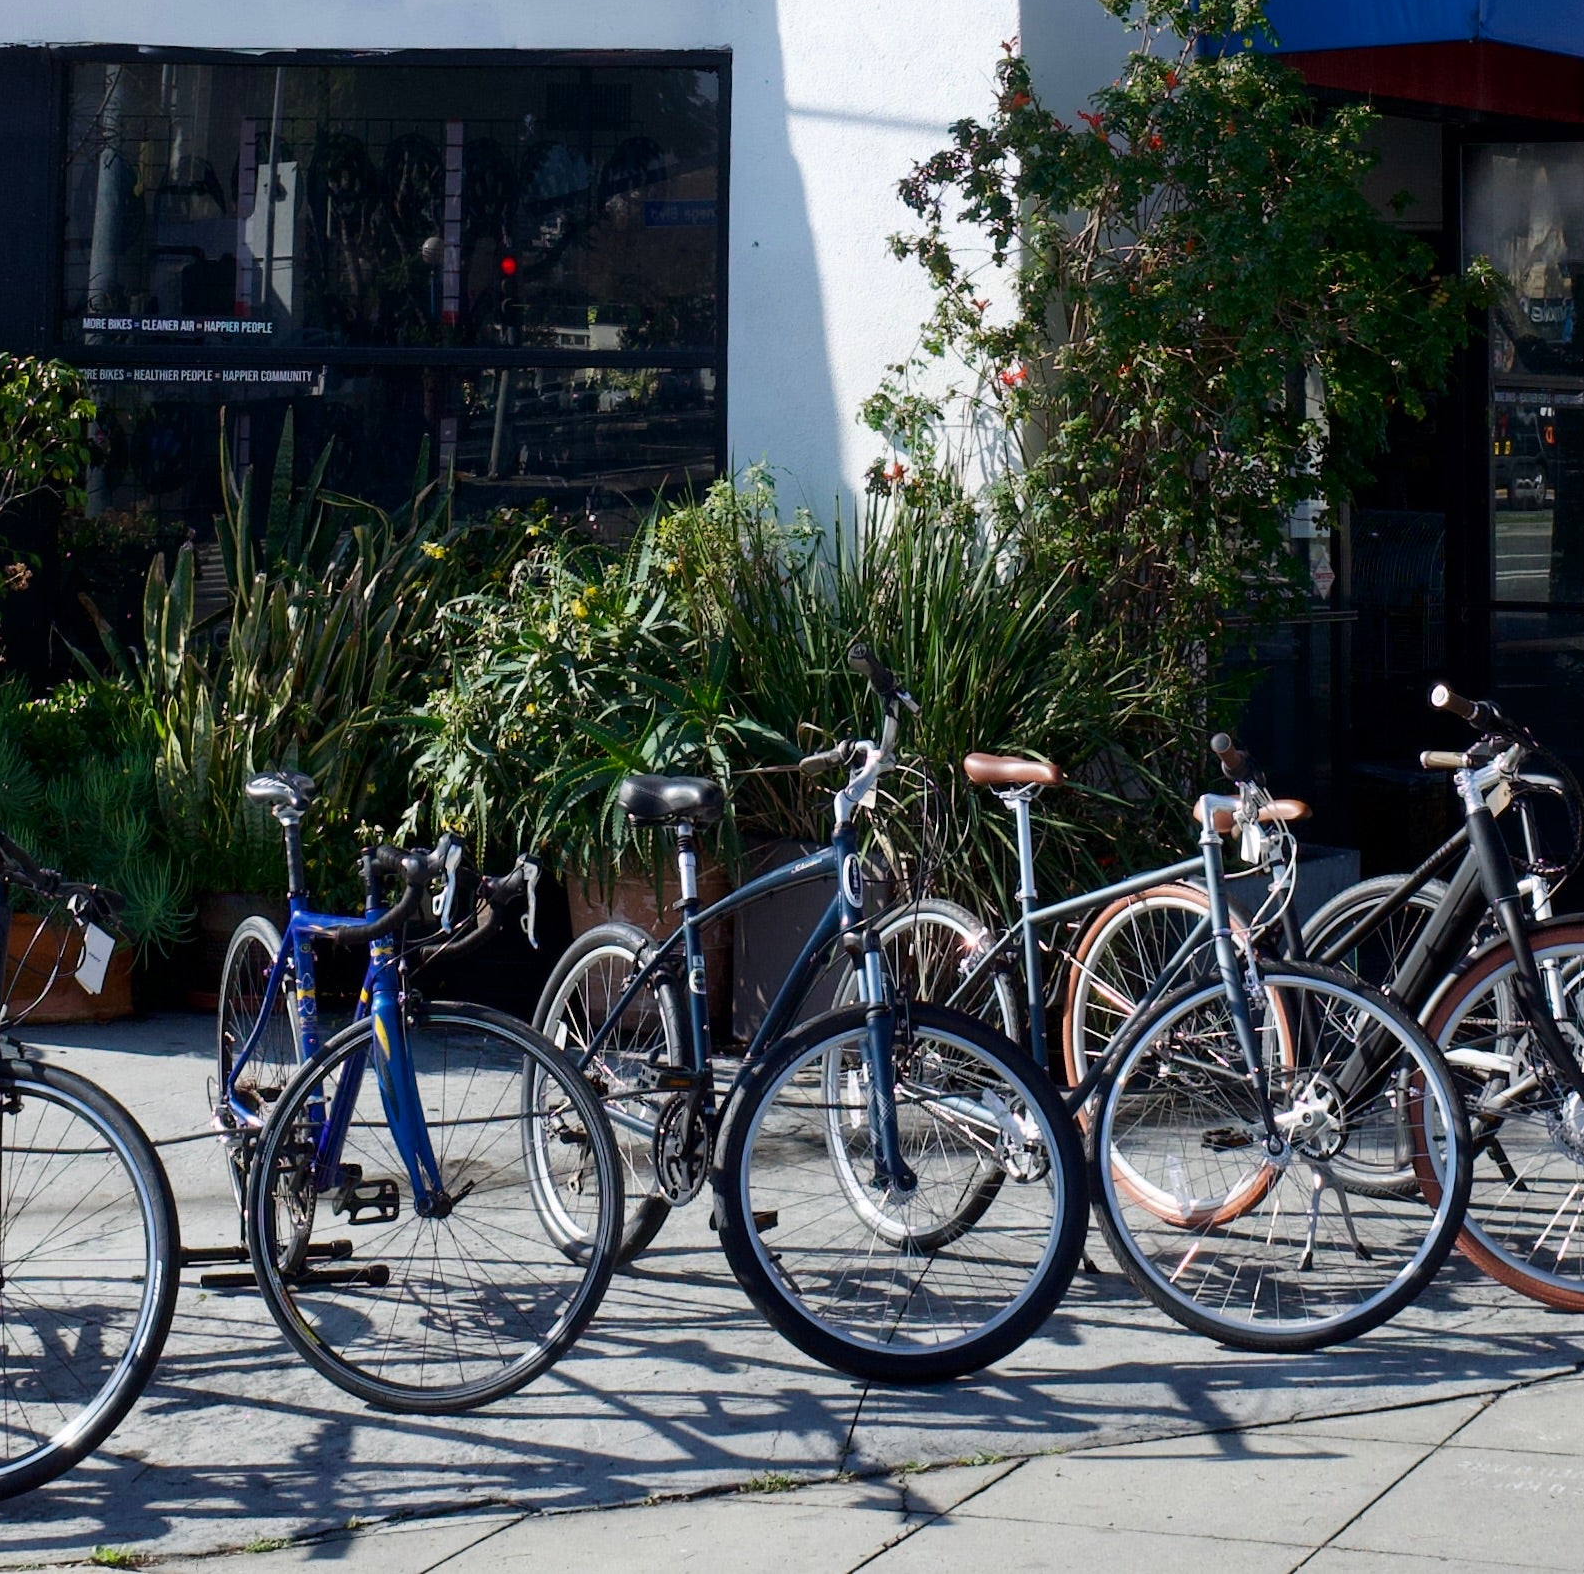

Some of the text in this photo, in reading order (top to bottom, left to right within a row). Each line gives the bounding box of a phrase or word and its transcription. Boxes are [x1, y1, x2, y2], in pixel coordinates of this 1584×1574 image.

[83, 317, 106, 330] MORE
[108, 318, 132, 330] BIKES
[142, 319, 179, 331] CLEANER
[180, 320, 195, 332] AIR
[204, 321, 239, 333] HAPPIER
[241, 322, 273, 334] PEOPLE
[99, 369, 124, 380] BIKES
[134, 369, 179, 381] HEALTHIER
[181, 369, 213, 381] PEOPLE
[222, 370, 258, 382] HAPPIER
[260, 370, 312, 382] COMMUNITY
